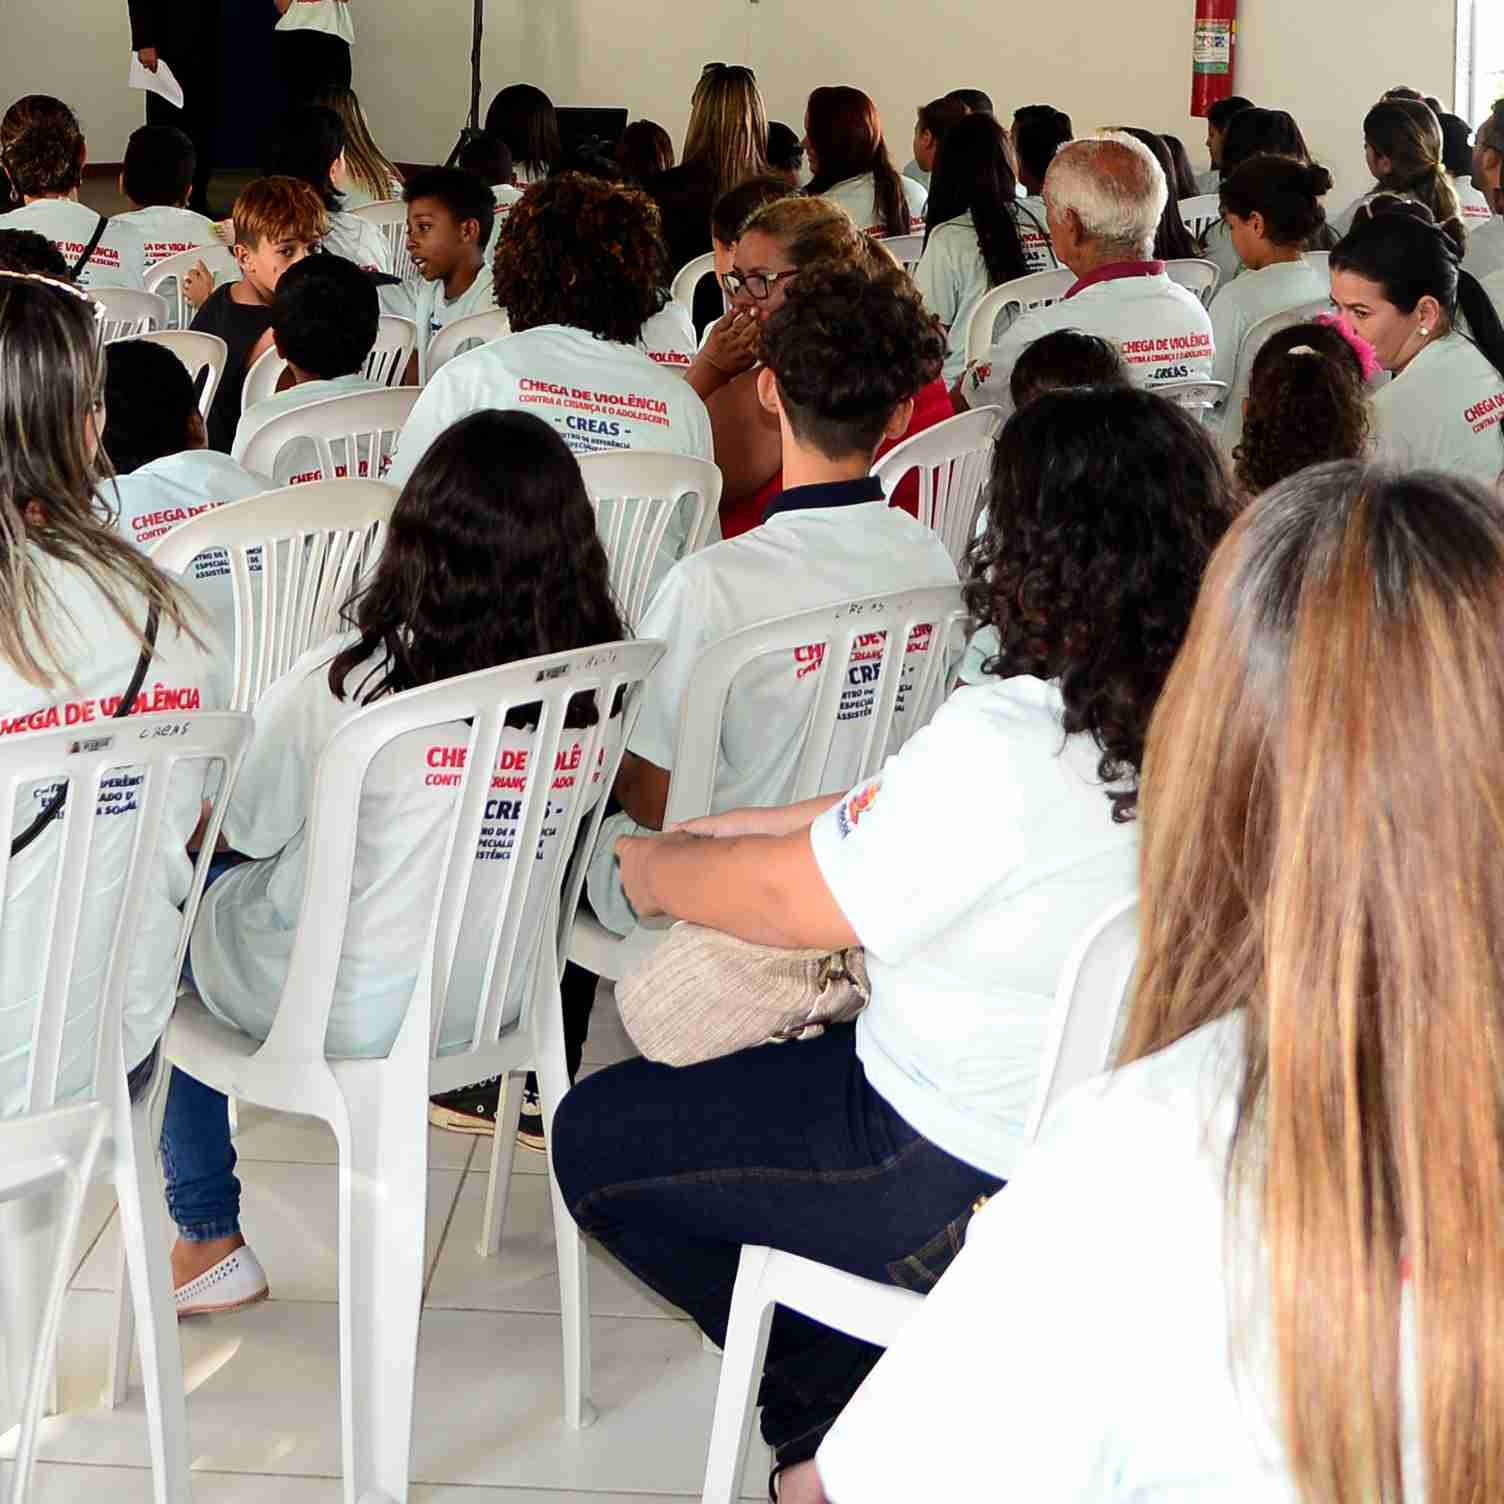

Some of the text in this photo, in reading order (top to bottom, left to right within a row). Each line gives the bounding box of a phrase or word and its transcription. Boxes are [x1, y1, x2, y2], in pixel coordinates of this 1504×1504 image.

[65, 242, 119, 260] VIONCIA
[1121, 332, 1210, 354] CHEGA DE VIOLÊNCI
[519, 378, 668, 414] CHEGA DE VIOLÊNCIA
[519, 395, 555, 407] CONTRA
[563, 399, 603, 415] CRIANÇA
[565, 415, 621, 436] CREAS
[289, 470, 322, 485] CHEG
[131, 506, 187, 531] CHEGA
[64, 702, 96, 726] DE
[499, 749, 529, 772] DE
